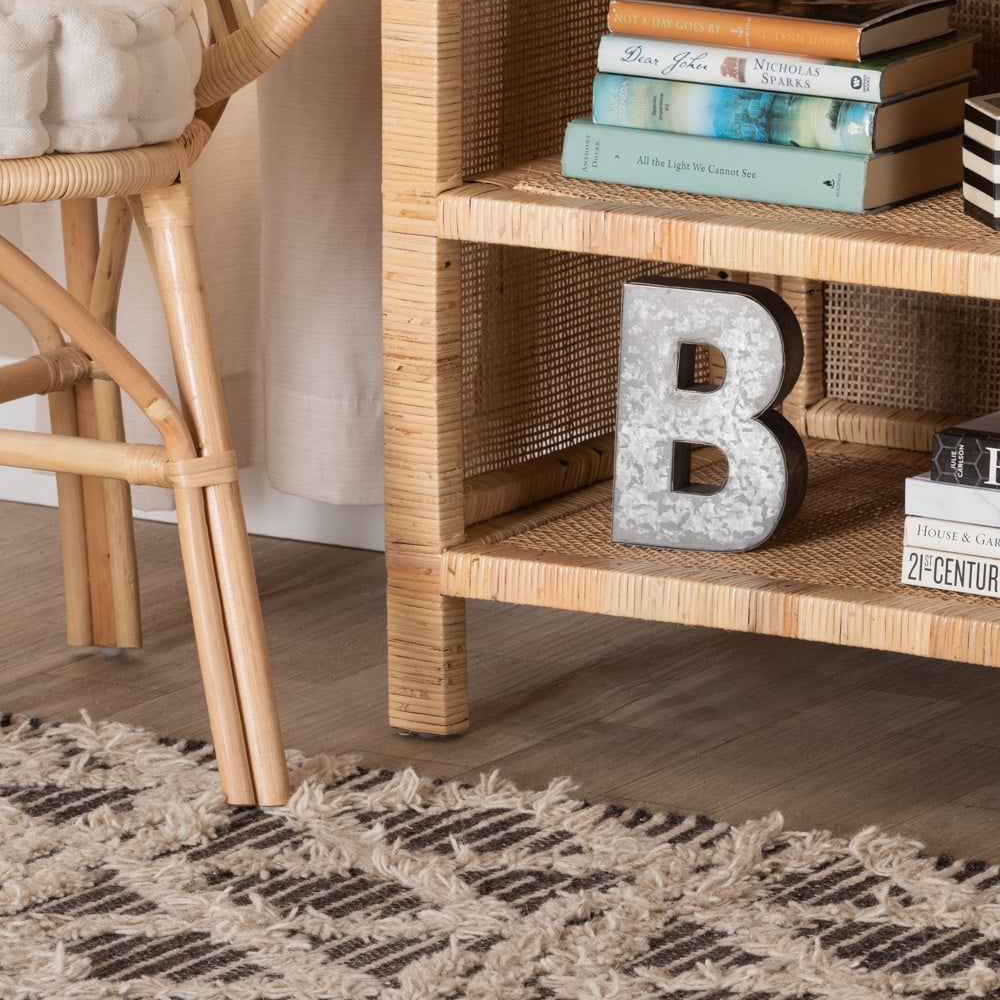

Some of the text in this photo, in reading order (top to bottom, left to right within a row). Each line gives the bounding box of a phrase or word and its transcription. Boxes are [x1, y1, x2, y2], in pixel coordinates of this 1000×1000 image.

[614, 13, 721, 34] NOT A DAY GOES BY
[620, 45, 709, 75] Dear John
[753, 58, 821, 77] NICHOLAS
[761, 72, 811, 89] SPARKS
[581, 134, 591, 173] ANTHONY
[592, 140, 600, 169] DOERR
[636, 155, 757, 179] All the Light We Cannot See
[612, 276, 808, 553] B
[957, 444, 965, 478] CARLSON
[917, 524, 958, 541] HOUSE
[961, 532, 971, 543] &
